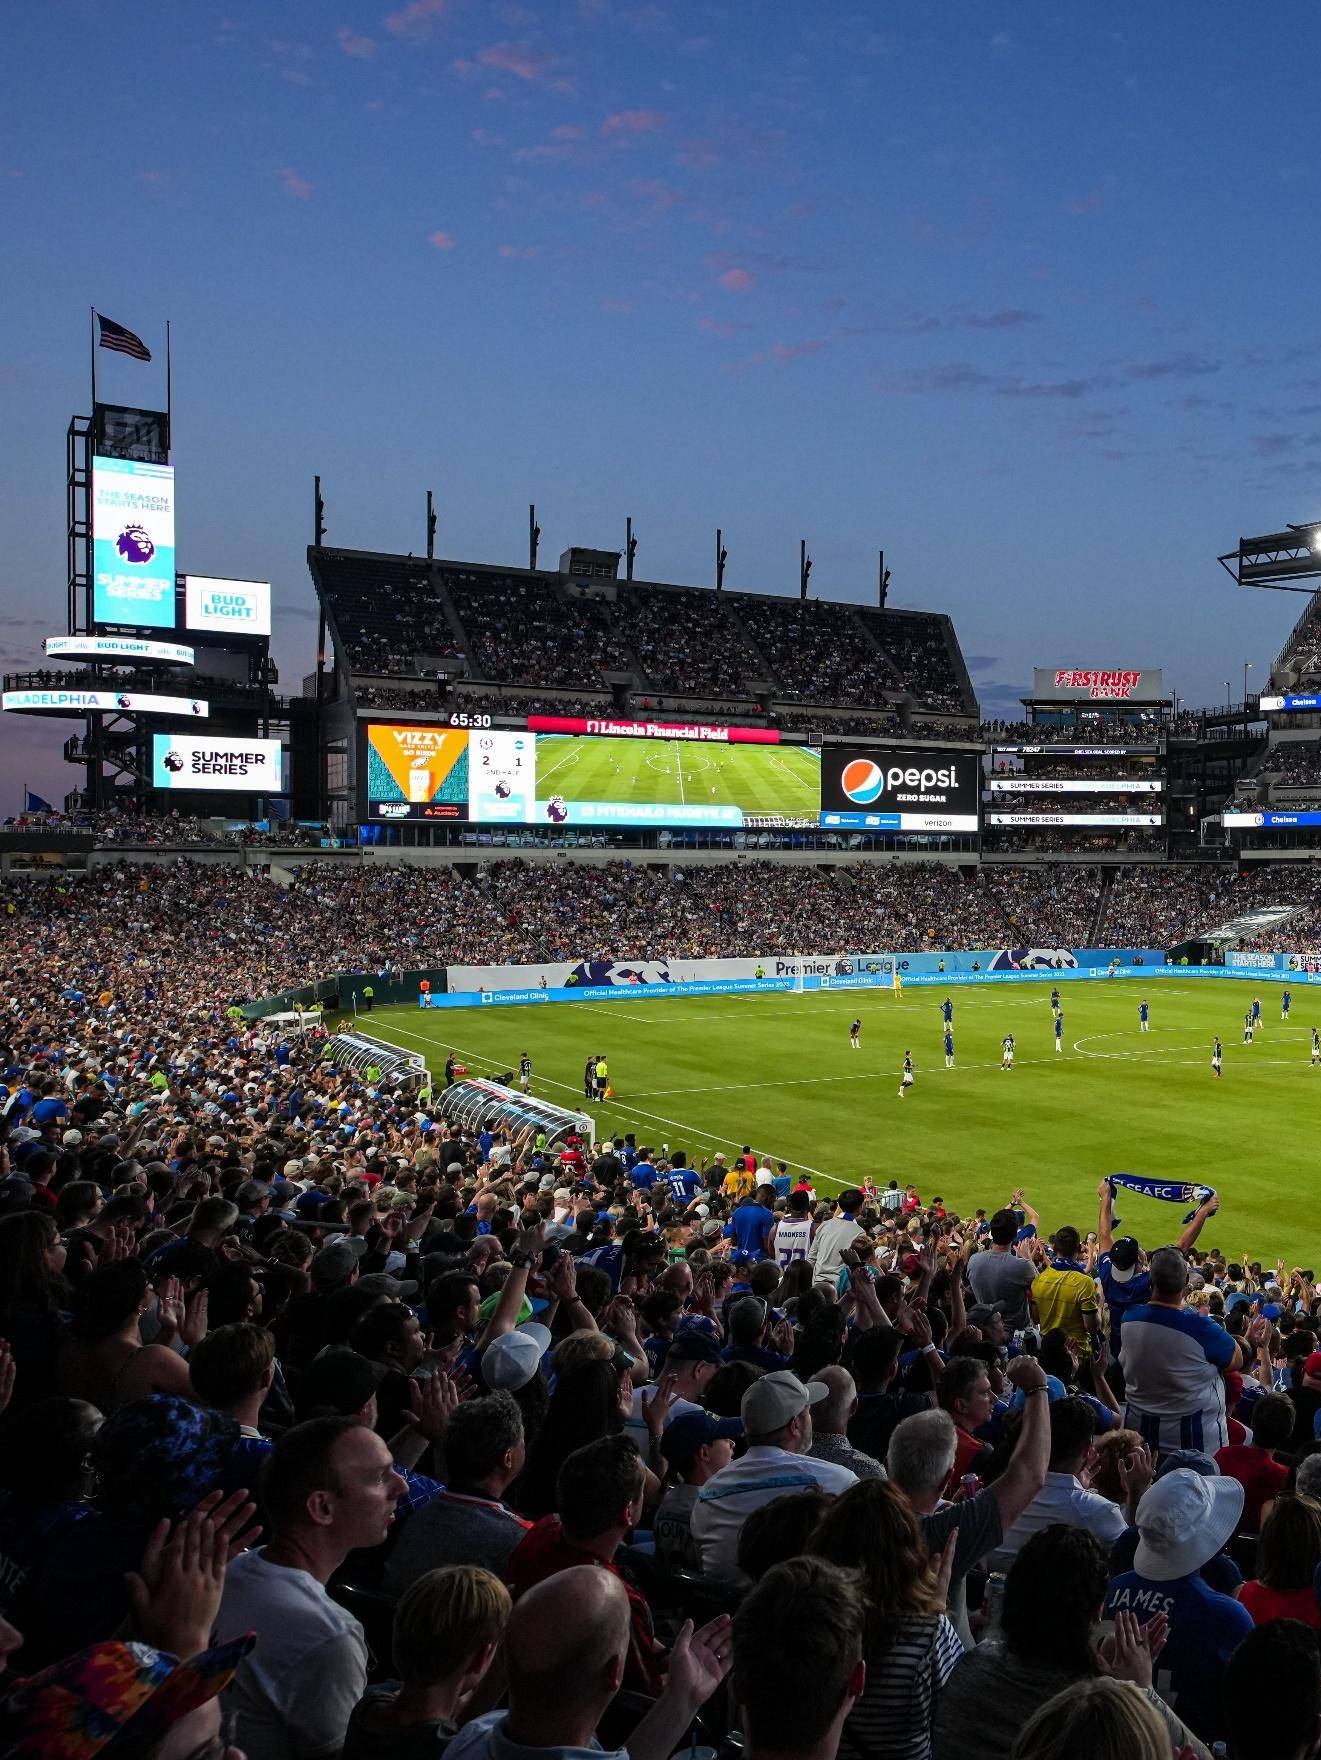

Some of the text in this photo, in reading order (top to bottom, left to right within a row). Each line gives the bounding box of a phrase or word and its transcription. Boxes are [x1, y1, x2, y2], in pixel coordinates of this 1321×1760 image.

[98, 490, 168, 504] THE SEASON
[97, 498, 171, 512] STARTS HERE
[97, 573, 170, 590] SUMMER
[106, 584, 162, 602] SERIES
[211, 594, 246, 606] BUD
[204, 603, 252, 618] LIGHT
[97, 642, 150, 652] BUD LIGHT
[1091, 687, 1131, 698] BANK
[450, 713, 491, 727] 65:30
[392, 731, 448, 745] VIZZY
[600, 722, 729, 741] Lincoln Financial Field
[191, 751, 266, 765] SUMMER
[482, 756, 522, 767] 2 1
[191, 763, 248, 776] SERIES
[919, 795, 946, 803] SUGAR
[776, 959, 909, 975] Premier League
[672, 1182, 686, 1196] 11
[1154, 1187, 1172, 1198] FC
[1108, 1588, 1175, 1614] JAMES
